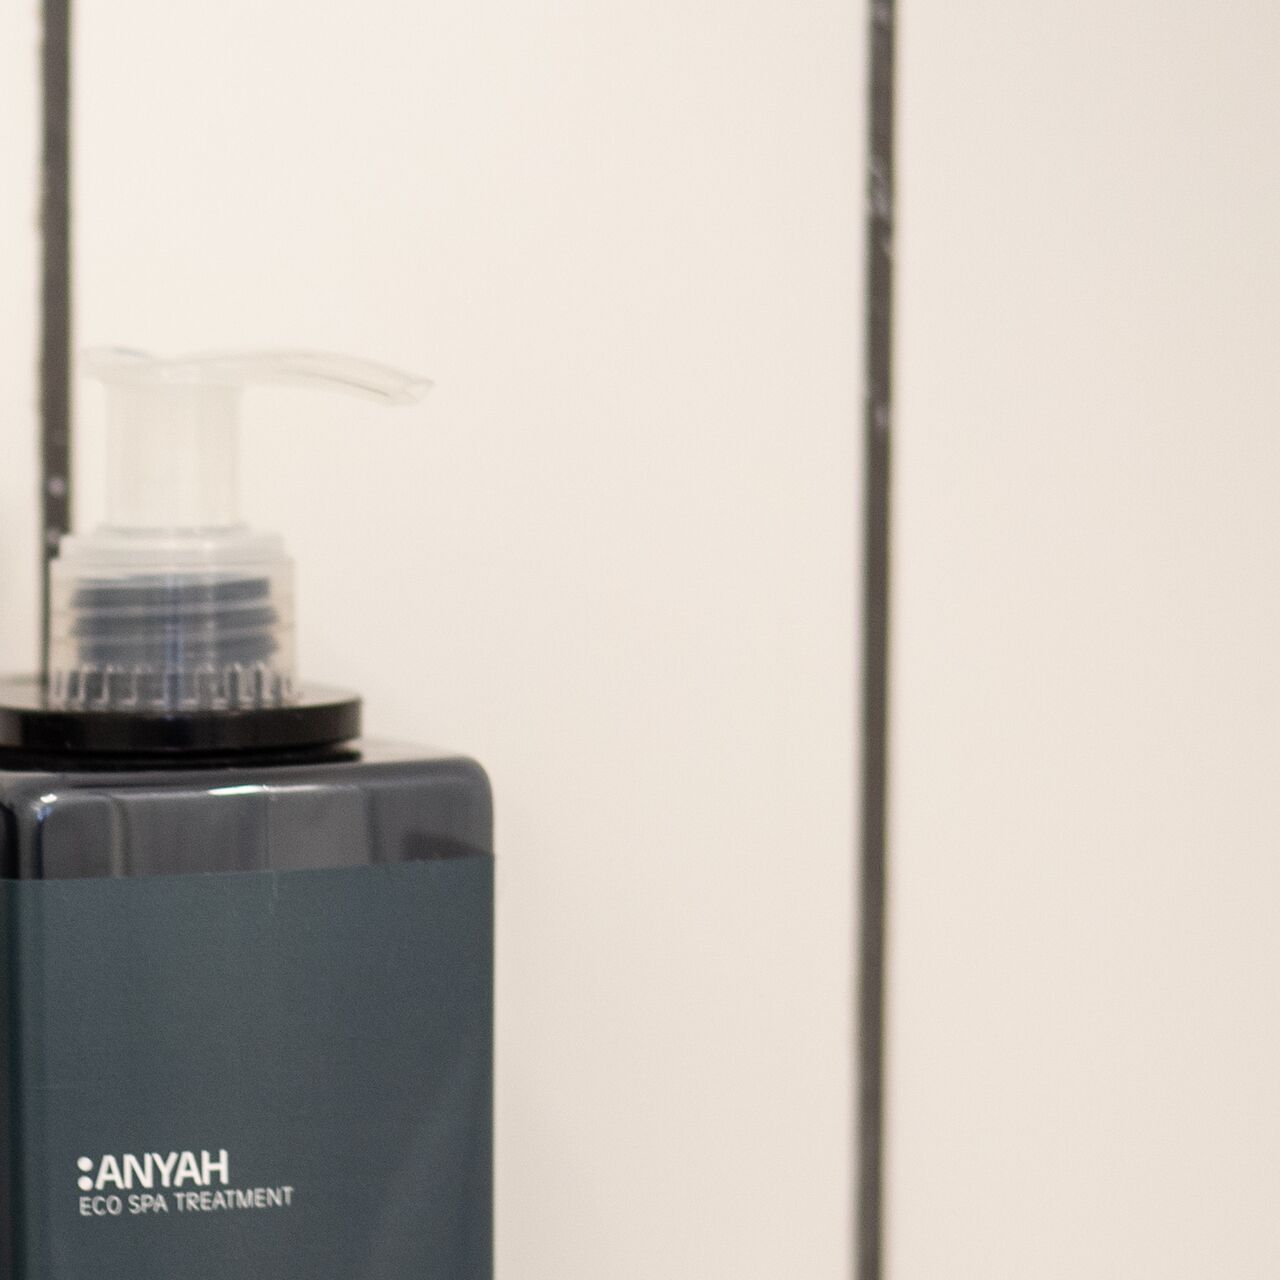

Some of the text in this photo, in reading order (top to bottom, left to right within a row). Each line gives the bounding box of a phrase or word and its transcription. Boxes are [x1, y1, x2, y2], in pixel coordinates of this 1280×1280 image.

[79, 1186, 294, 1216] ECO SPA TREATMENT
